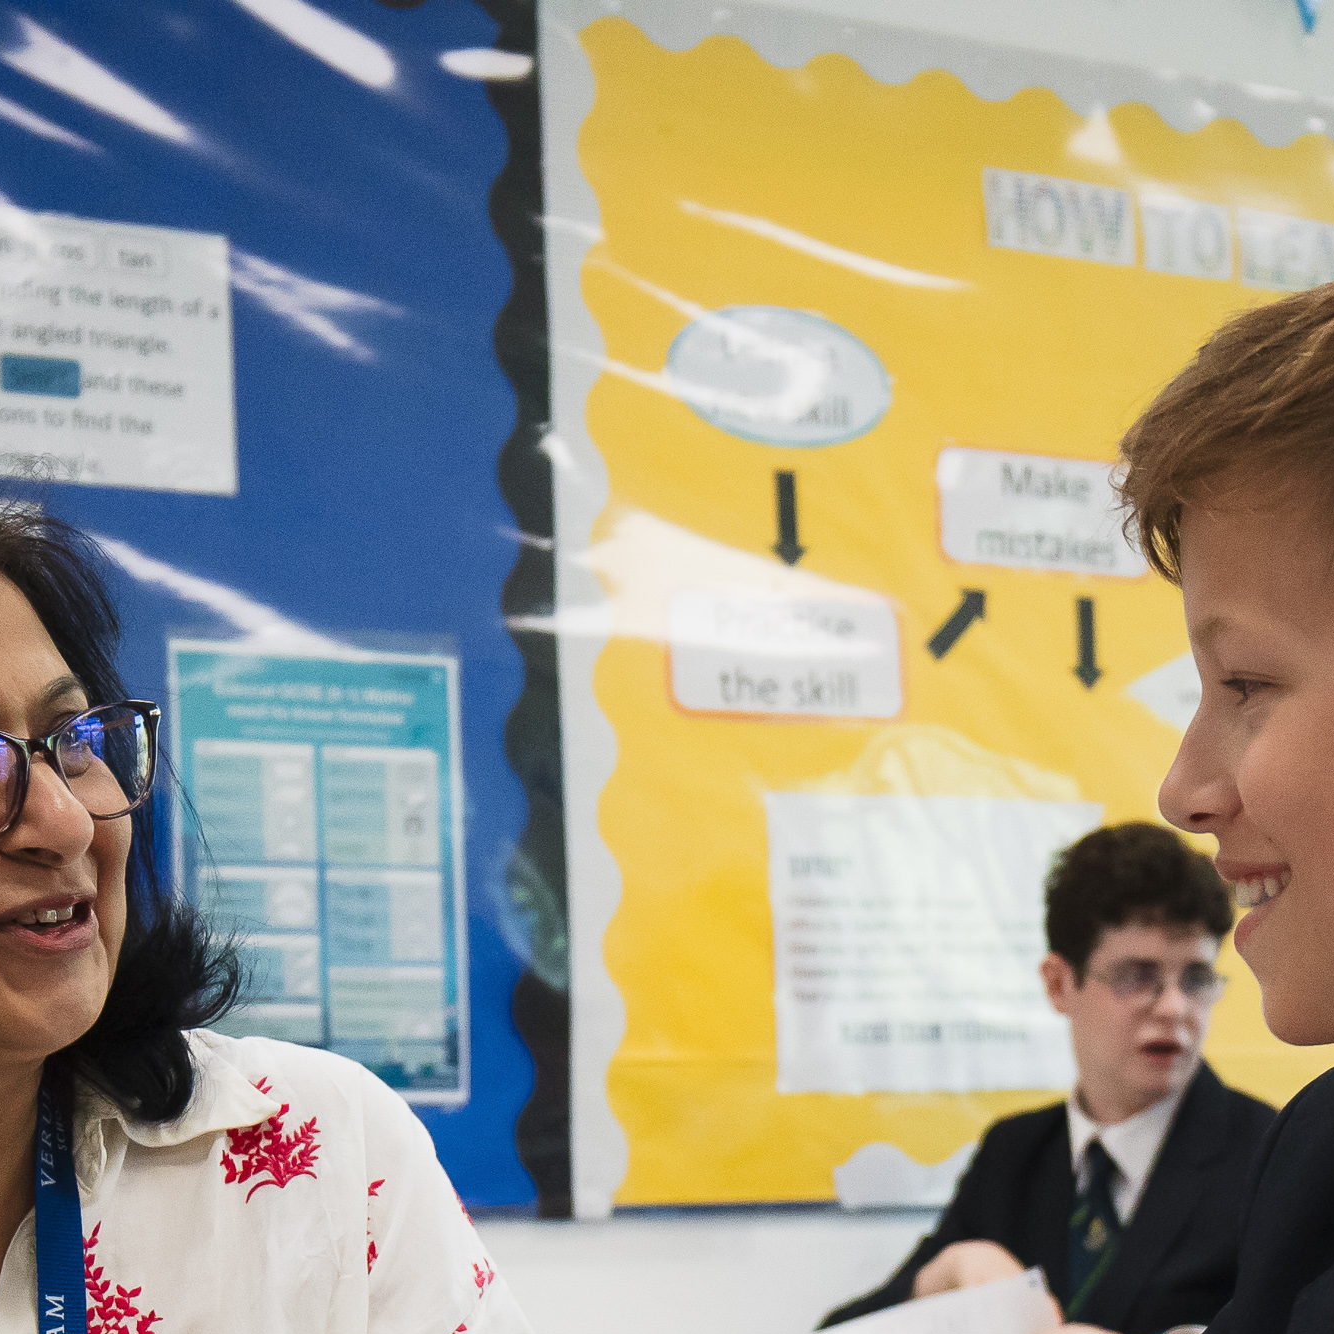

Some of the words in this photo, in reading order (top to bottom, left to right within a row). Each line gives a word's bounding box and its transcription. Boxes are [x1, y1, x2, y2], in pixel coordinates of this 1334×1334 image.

[989, 172, 1127, 255] HOW
[1000, 462, 1091, 503] Make
[977, 530, 1117, 568] mistakes
[720, 667, 779, 706] the
[791, 669, 857, 708] skill
